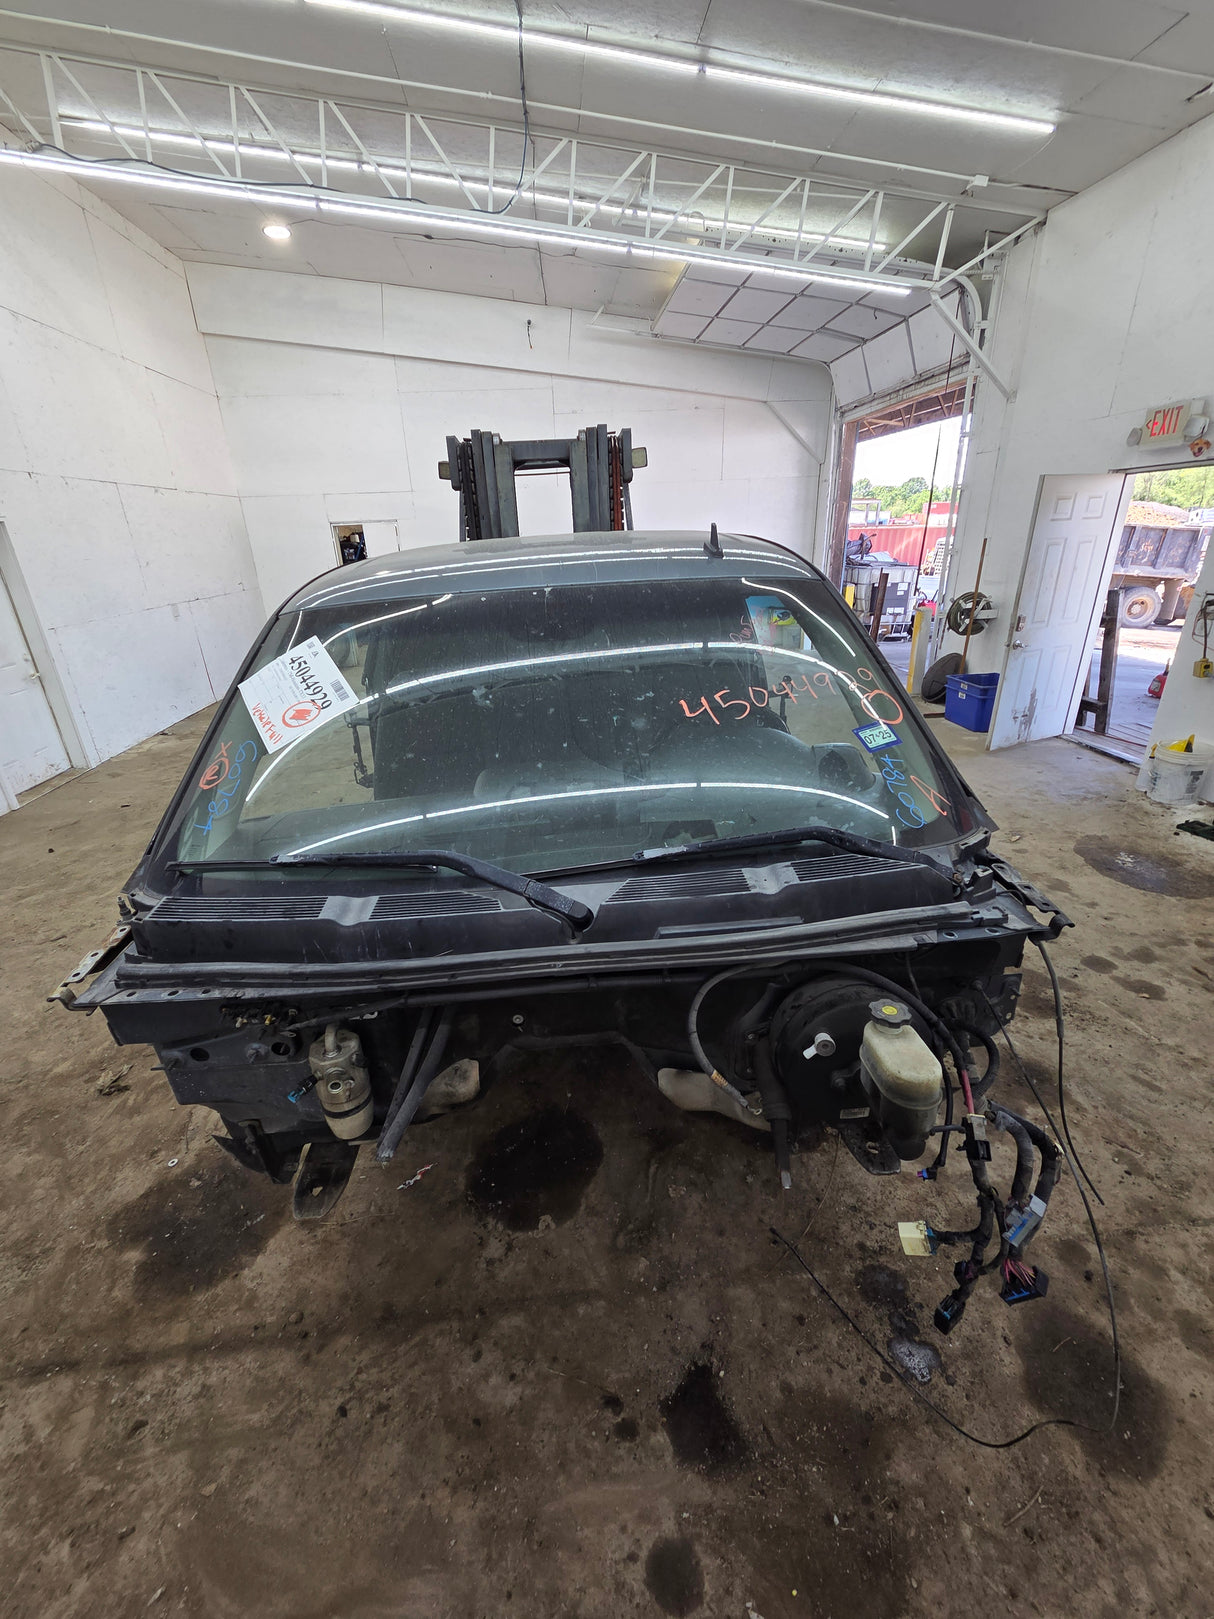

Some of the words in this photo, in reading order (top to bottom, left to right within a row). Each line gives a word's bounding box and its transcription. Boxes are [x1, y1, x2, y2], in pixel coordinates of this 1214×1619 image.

[1150, 405, 1184, 437] EXIT
[288, 656, 333, 710] 45044929
[679, 667, 884, 725] 45044929
[863, 732, 877, 745] 07
[878, 729, 892, 741] 25
